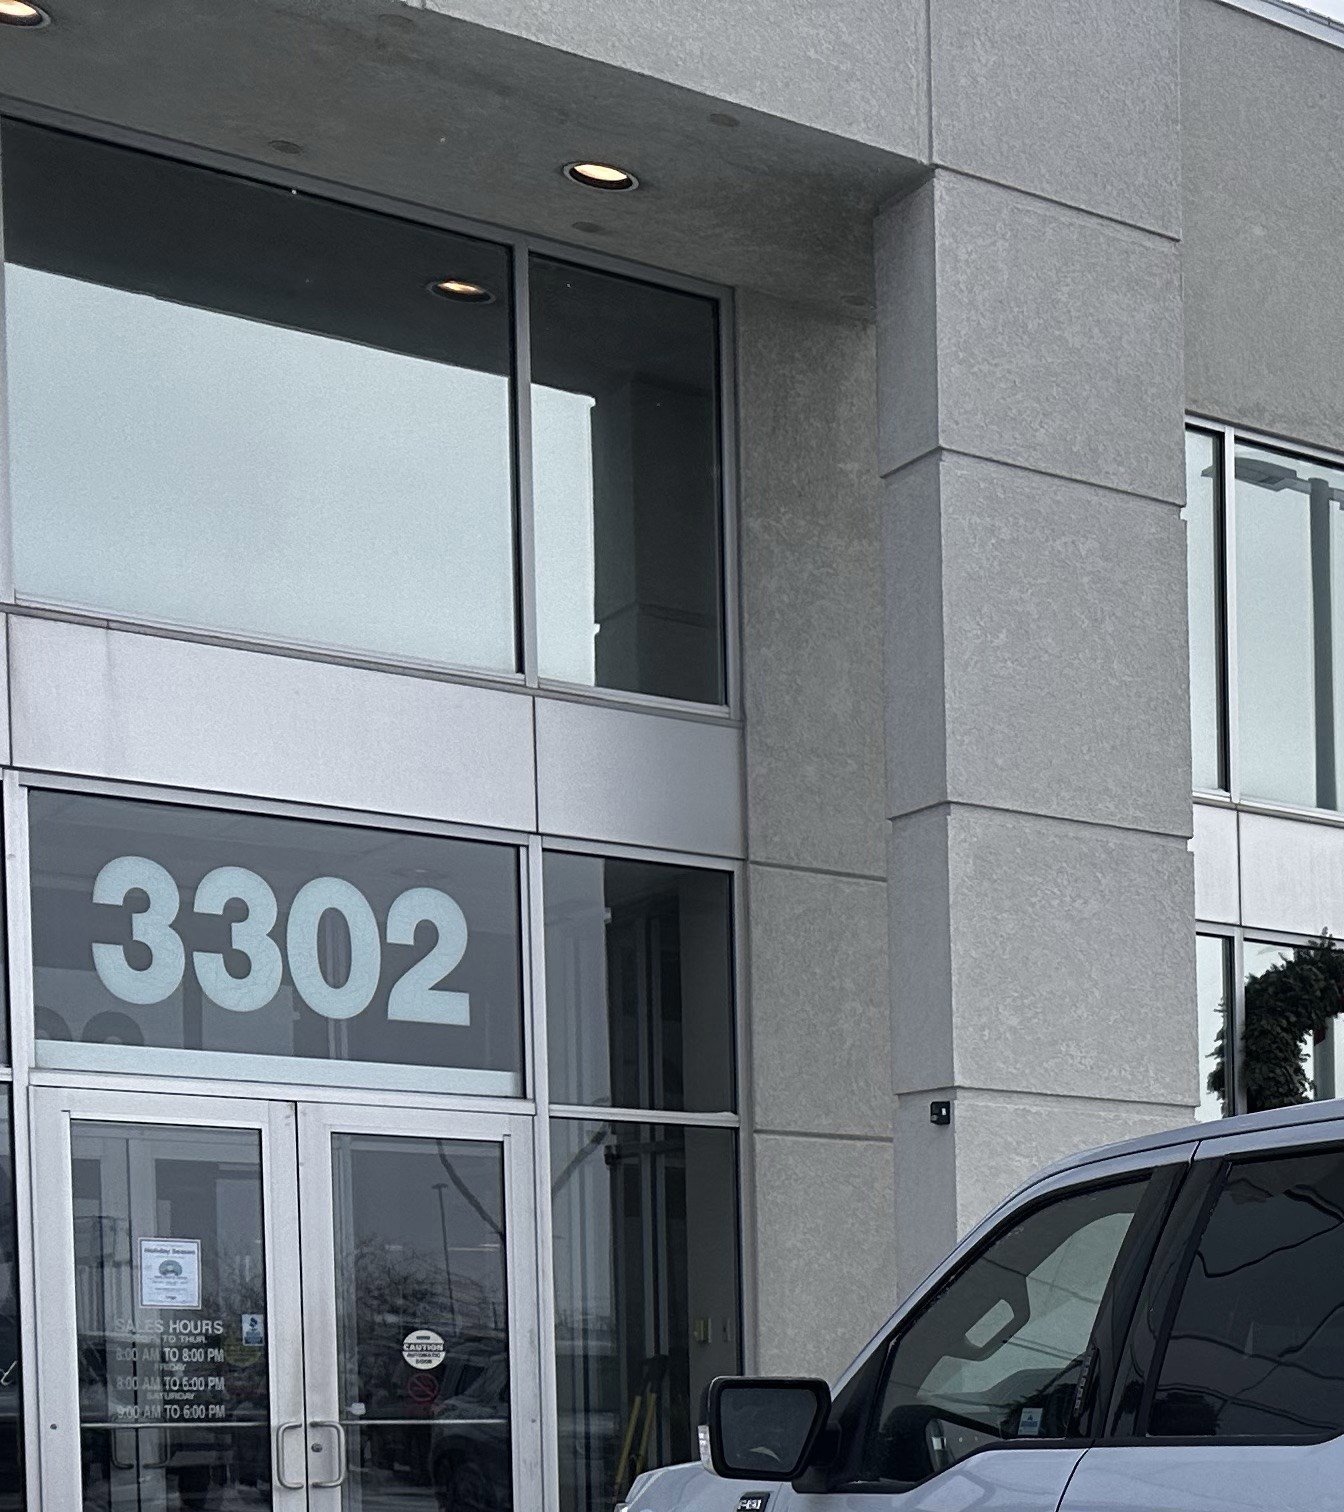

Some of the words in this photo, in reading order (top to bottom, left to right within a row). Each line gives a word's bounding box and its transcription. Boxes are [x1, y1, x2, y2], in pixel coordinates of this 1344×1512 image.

[92, 855, 471, 1027] 3302
[115, 1319, 164, 1333] SALES
[169, 1319, 224, 1335] HOURS
[403, 1343, 444, 1351] CAUTION
[164, 1347, 179, 1362] TO
[182, 1347, 205, 1362] 8:00
[207, 1348, 225, 1363] PM
[164, 1376, 179, 1391] TO
[182, 1376, 206, 1391] 6:00
[207, 1376, 226, 1391] PM
[143, 1404, 161, 1419] AM
[164, 1404, 180, 1419] TO
[183, 1404, 206, 1419] 6:00
[208, 1404, 226, 1419] PM
